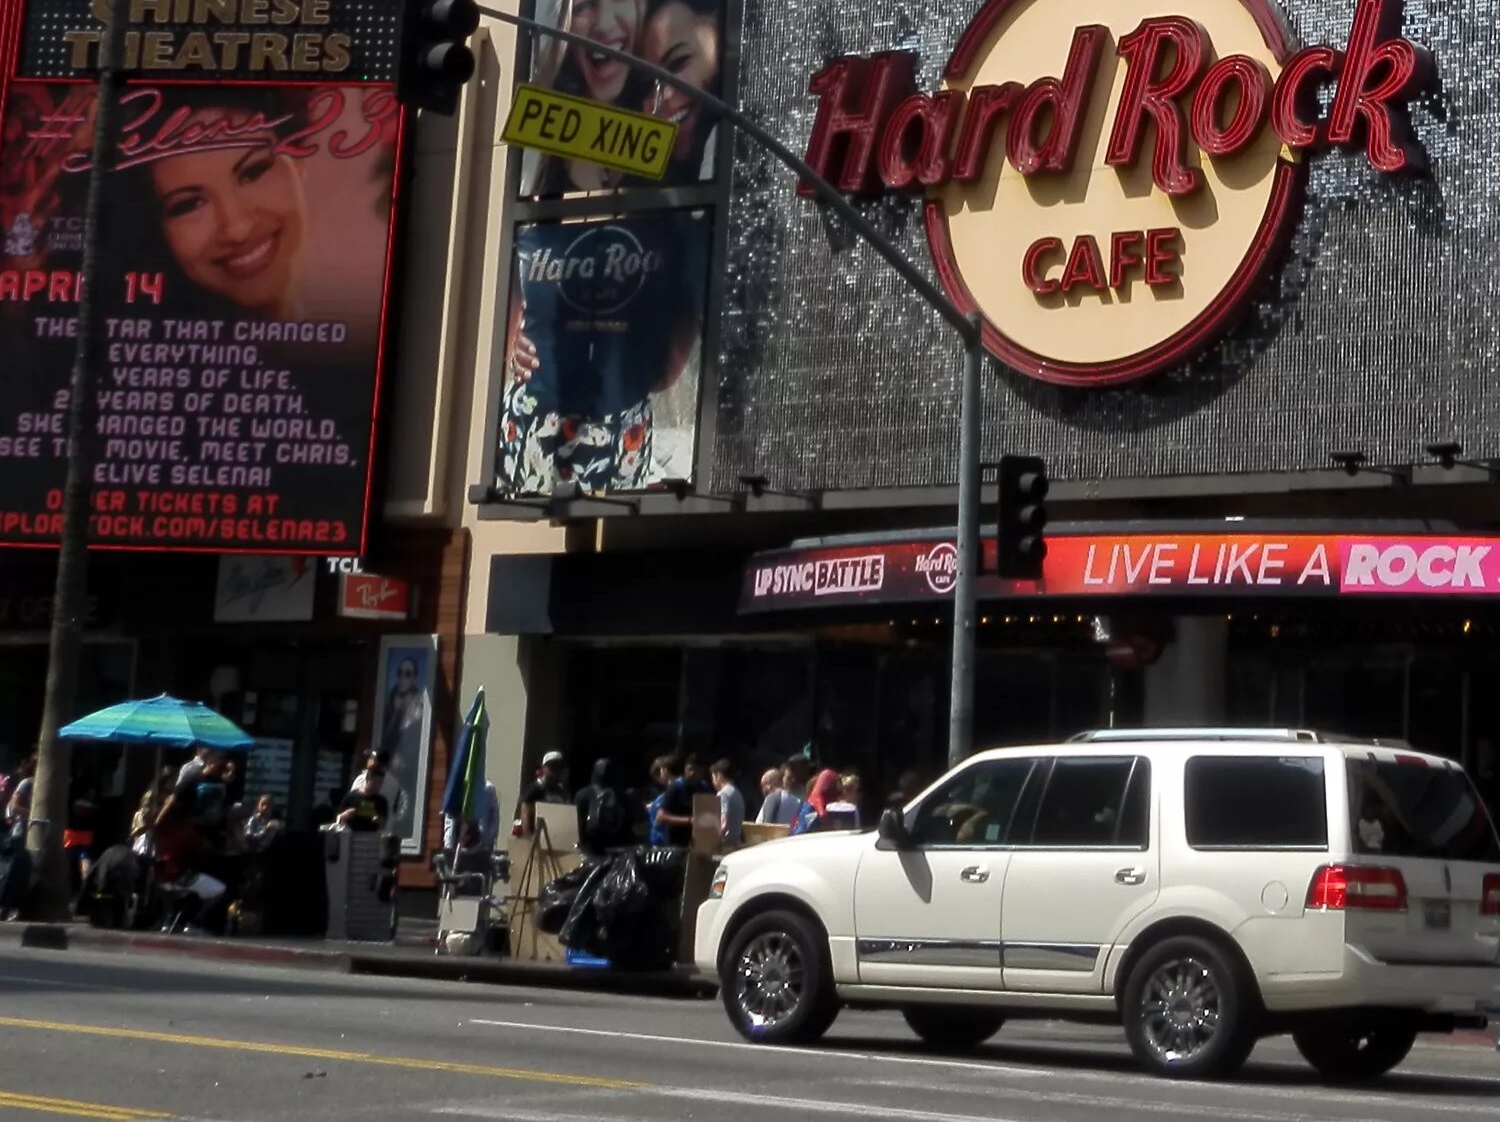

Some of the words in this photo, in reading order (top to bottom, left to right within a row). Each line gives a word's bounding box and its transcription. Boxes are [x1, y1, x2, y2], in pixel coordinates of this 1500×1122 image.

[797, 23, 1111, 197] Hard
[519, 99, 582, 144] PED
[590, 116, 662, 163] XING
[604, 243, 661, 283] Roc
[1023, 227, 1184, 295] CAFE
[0, 270, 84, 302] APRI
[125, 271, 165, 305] 14
[34, 317, 79, 338] THE
[105, 318, 152, 339] TAR
[163, 320, 225, 341] THAT
[234, 322, 347, 343] CHANGED
[108, 343, 264, 366] EVERYTHING.
[113, 367, 191, 388] YEARS
[201, 369, 229, 389] OF
[241, 370, 297, 391] LIFE.
[97, 391, 174, 412] YEARS
[185, 393, 213, 413] OF
[224, 394, 309, 415] DEATH.
[18, 413, 64, 433] SHE
[199, 418, 242, 438] THE
[252, 419, 343, 441] WORLD.
[106, 439, 189, 462] MOVIE,
[200, 441, 266, 462] MEET
[276, 443, 358, 467] CHRIS,
[94, 464, 160, 485] ELIVE
[171, 465, 272, 487] SELENA!
[137, 493, 236, 515] TICKETS
[247, 495, 280, 515] AT
[327, 557, 363, 574] TCL
[773, 562, 815, 595] SYNC
[818, 558, 882, 590] BATTLE
[1083, 542, 1178, 585] LIVE
[1185, 543, 1288, 585] LIKE
[1297, 543, 1331, 585] A
[1344, 544, 1492, 588] ROCK
